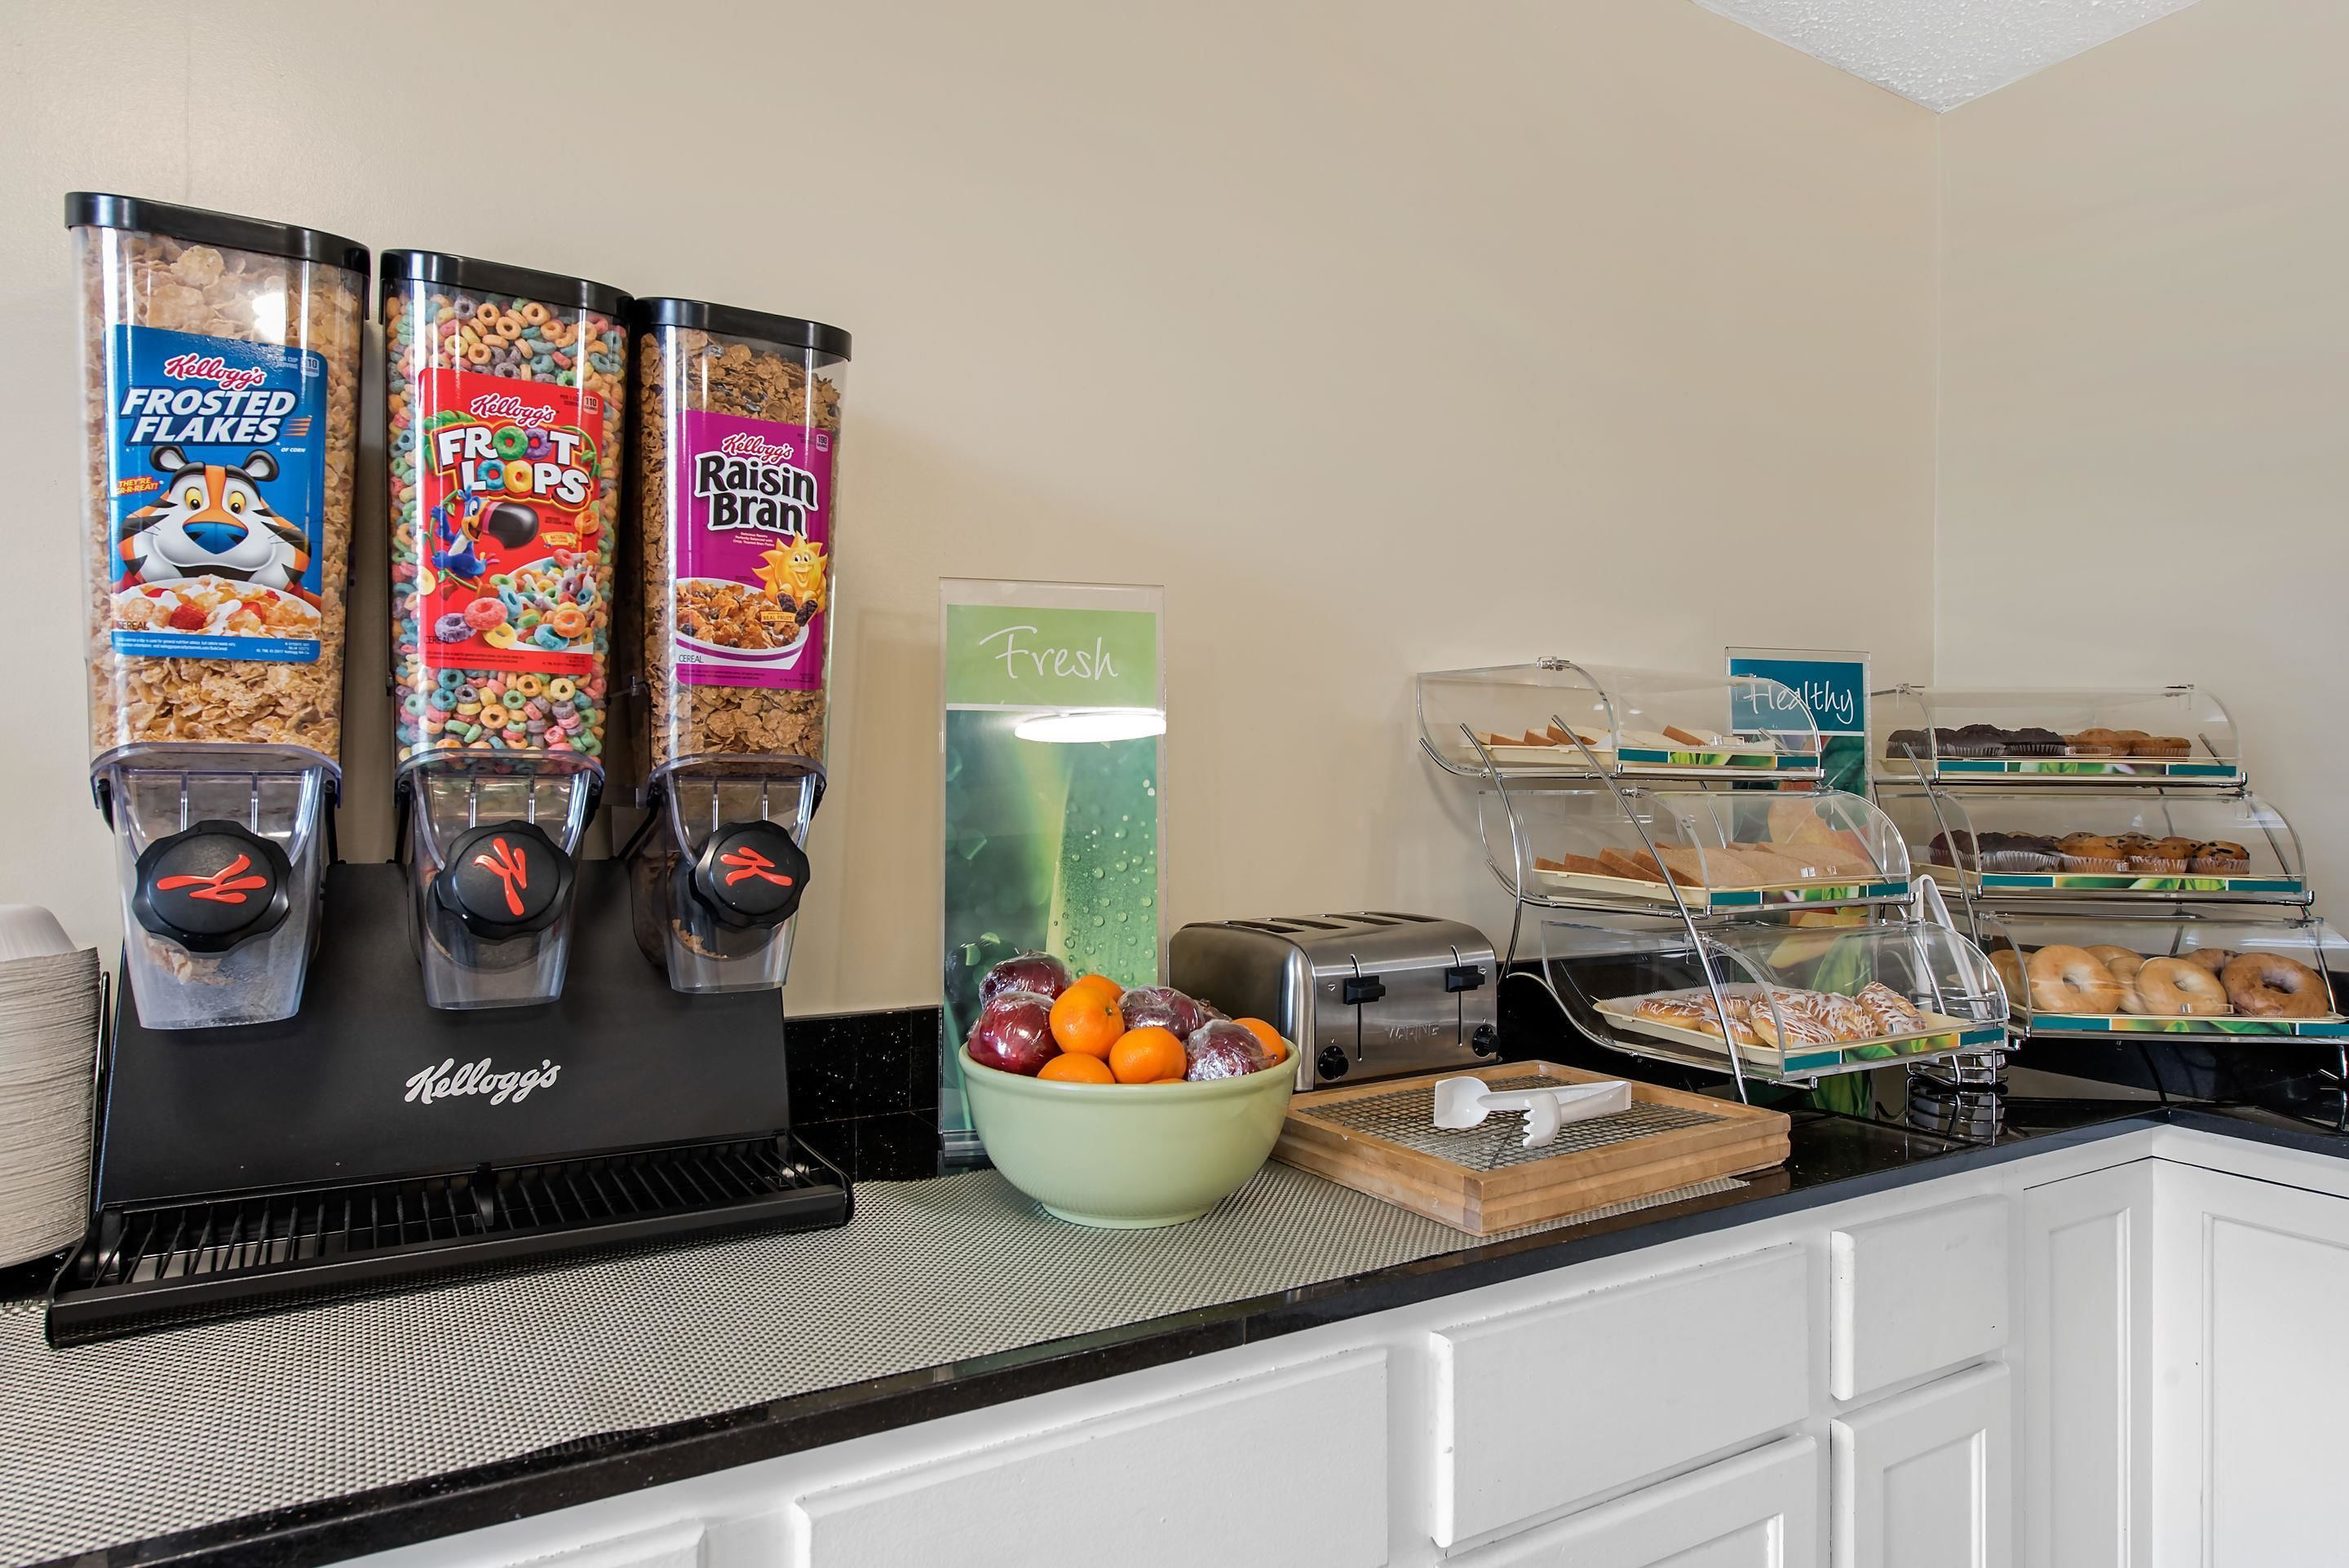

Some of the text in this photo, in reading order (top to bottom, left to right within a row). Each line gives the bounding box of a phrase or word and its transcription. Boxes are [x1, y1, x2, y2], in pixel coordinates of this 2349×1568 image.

[166, 354, 266, 390] Kellogg's
[121, 389, 296, 416] FROSTED
[472, 395, 555, 426] Kellogg's
[586, 397, 597, 406] 110
[130, 417, 281, 443] FLAKES
[438, 426, 580, 466] FROOT
[723, 434, 793, 462] Kellogg's
[461, 459, 589, 503] LOOPS
[698, 454, 816, 507] Raisin
[712, 492, 803, 537] Bran
[678, 654, 704, 664] CEREAL
[979, 625, 1119, 680] Fresh
[1743, 680, 1854, 725] Healthy
[405, 1058, 561, 1106] Kellogg's
